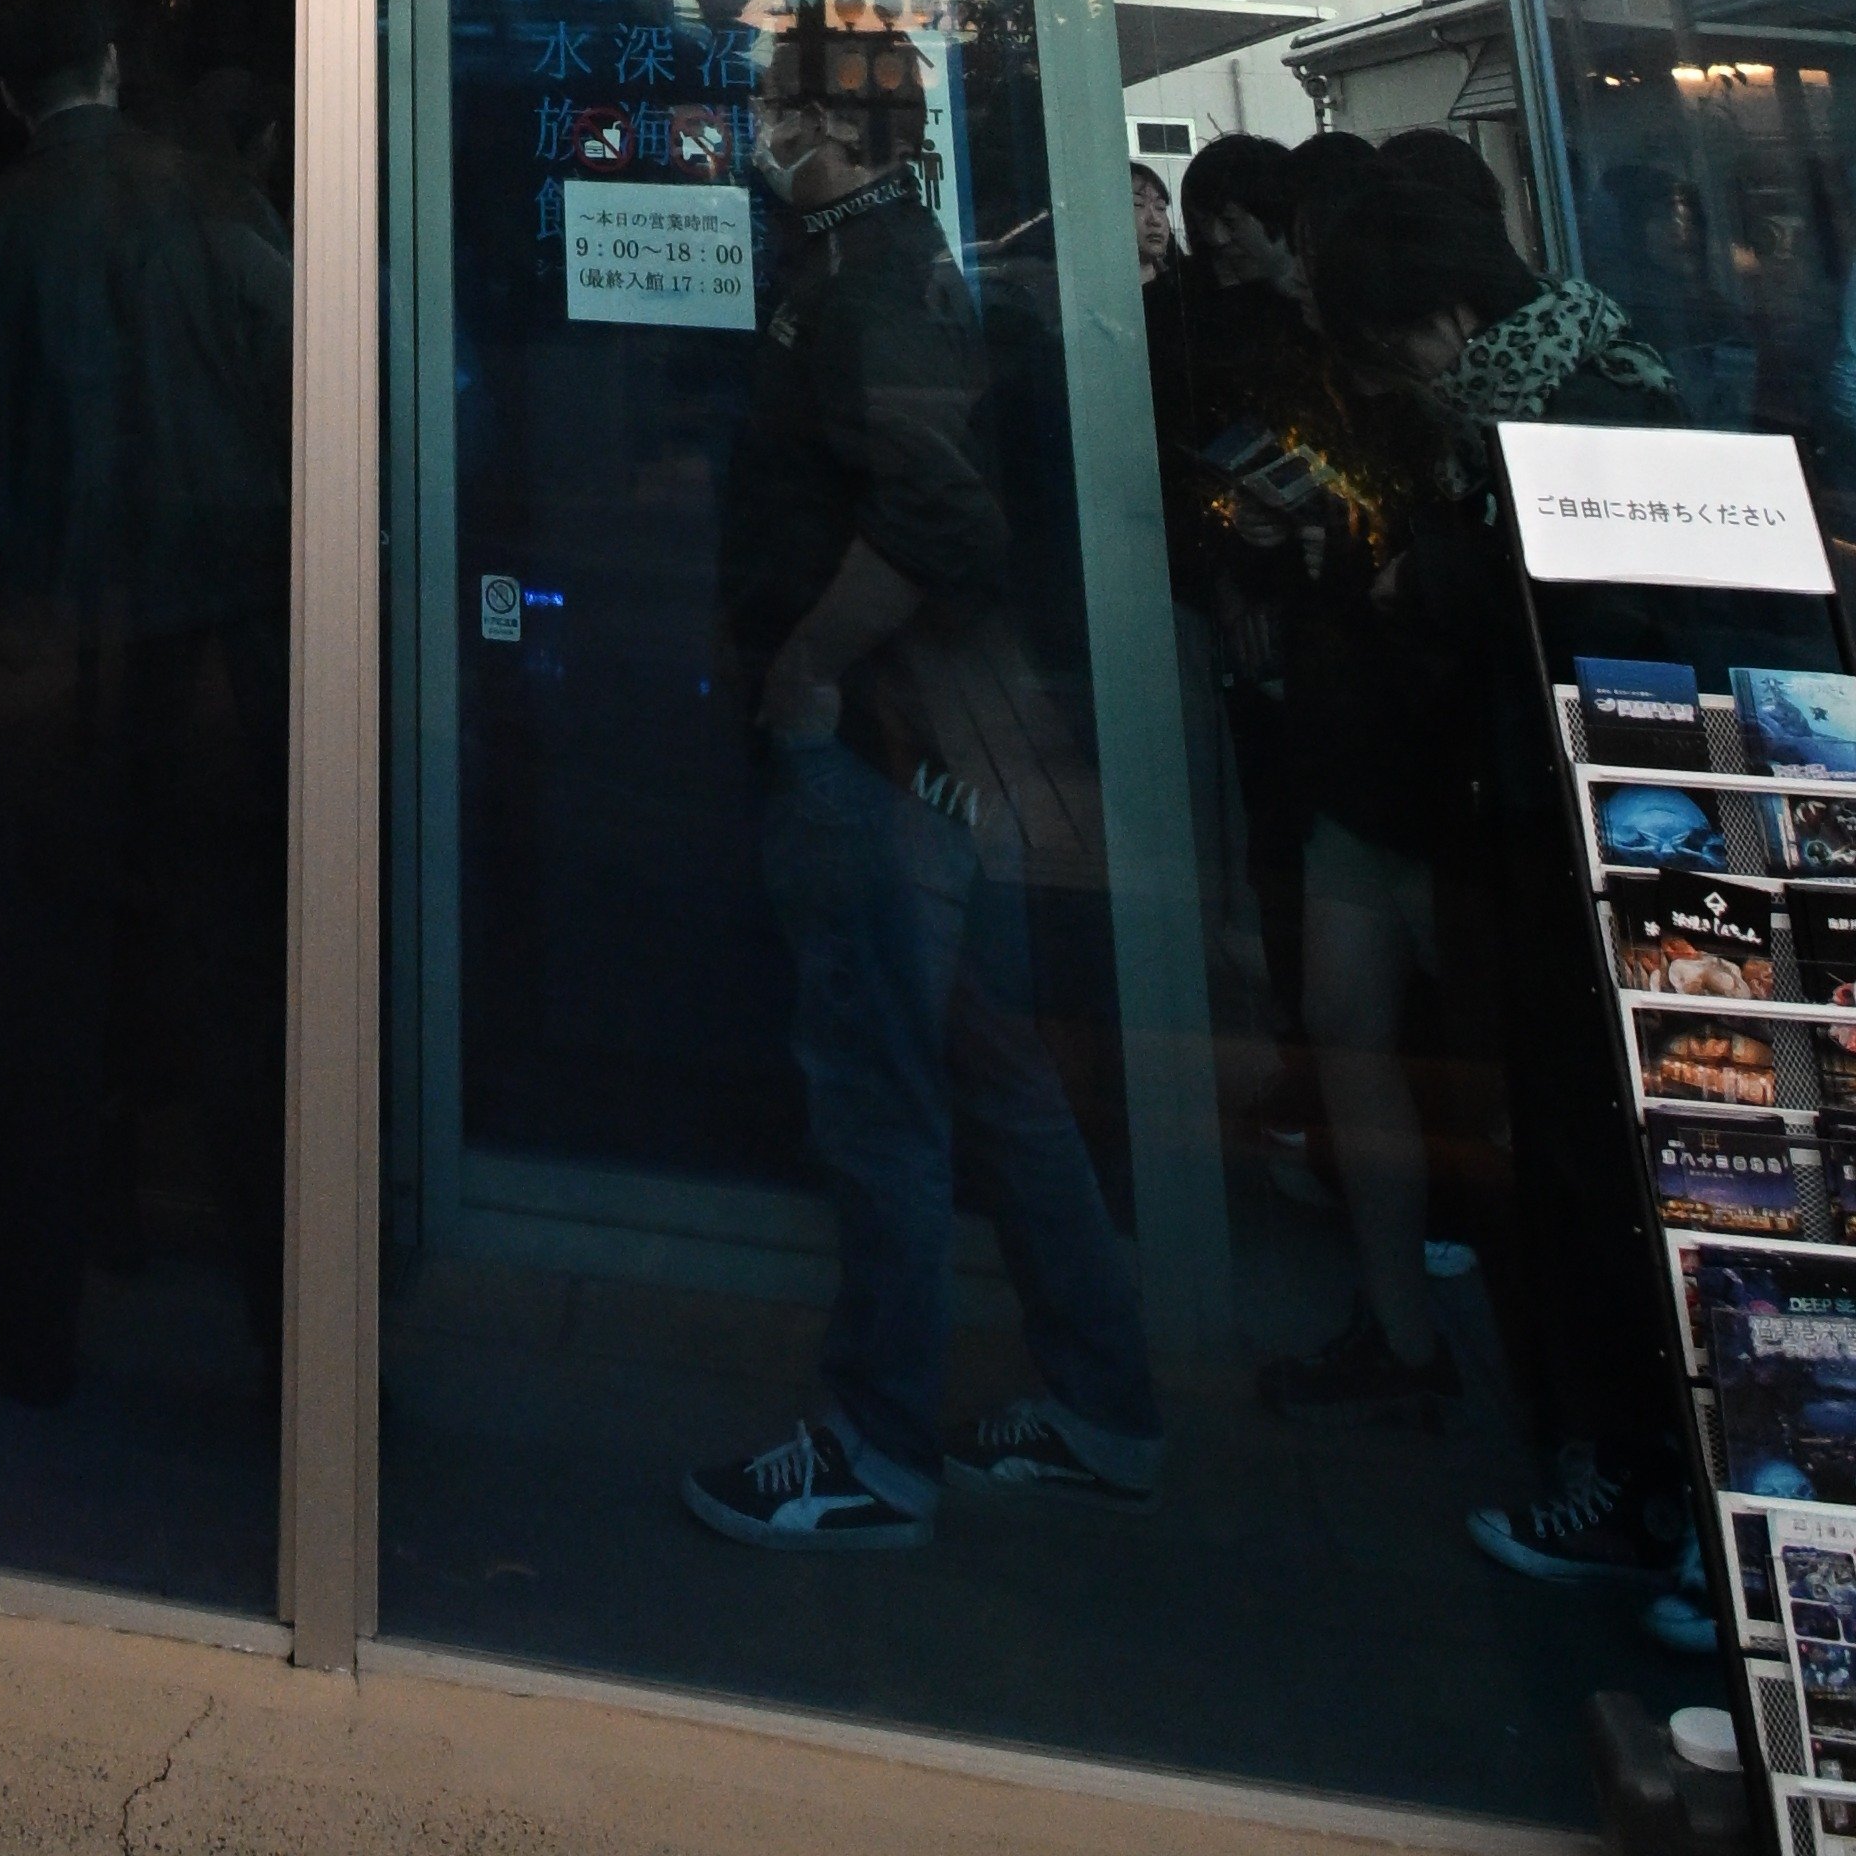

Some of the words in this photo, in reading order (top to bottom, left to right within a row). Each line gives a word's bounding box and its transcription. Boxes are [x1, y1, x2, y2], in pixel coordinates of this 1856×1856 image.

[1536, 494, 1787, 527] ご自由にお持ちください
